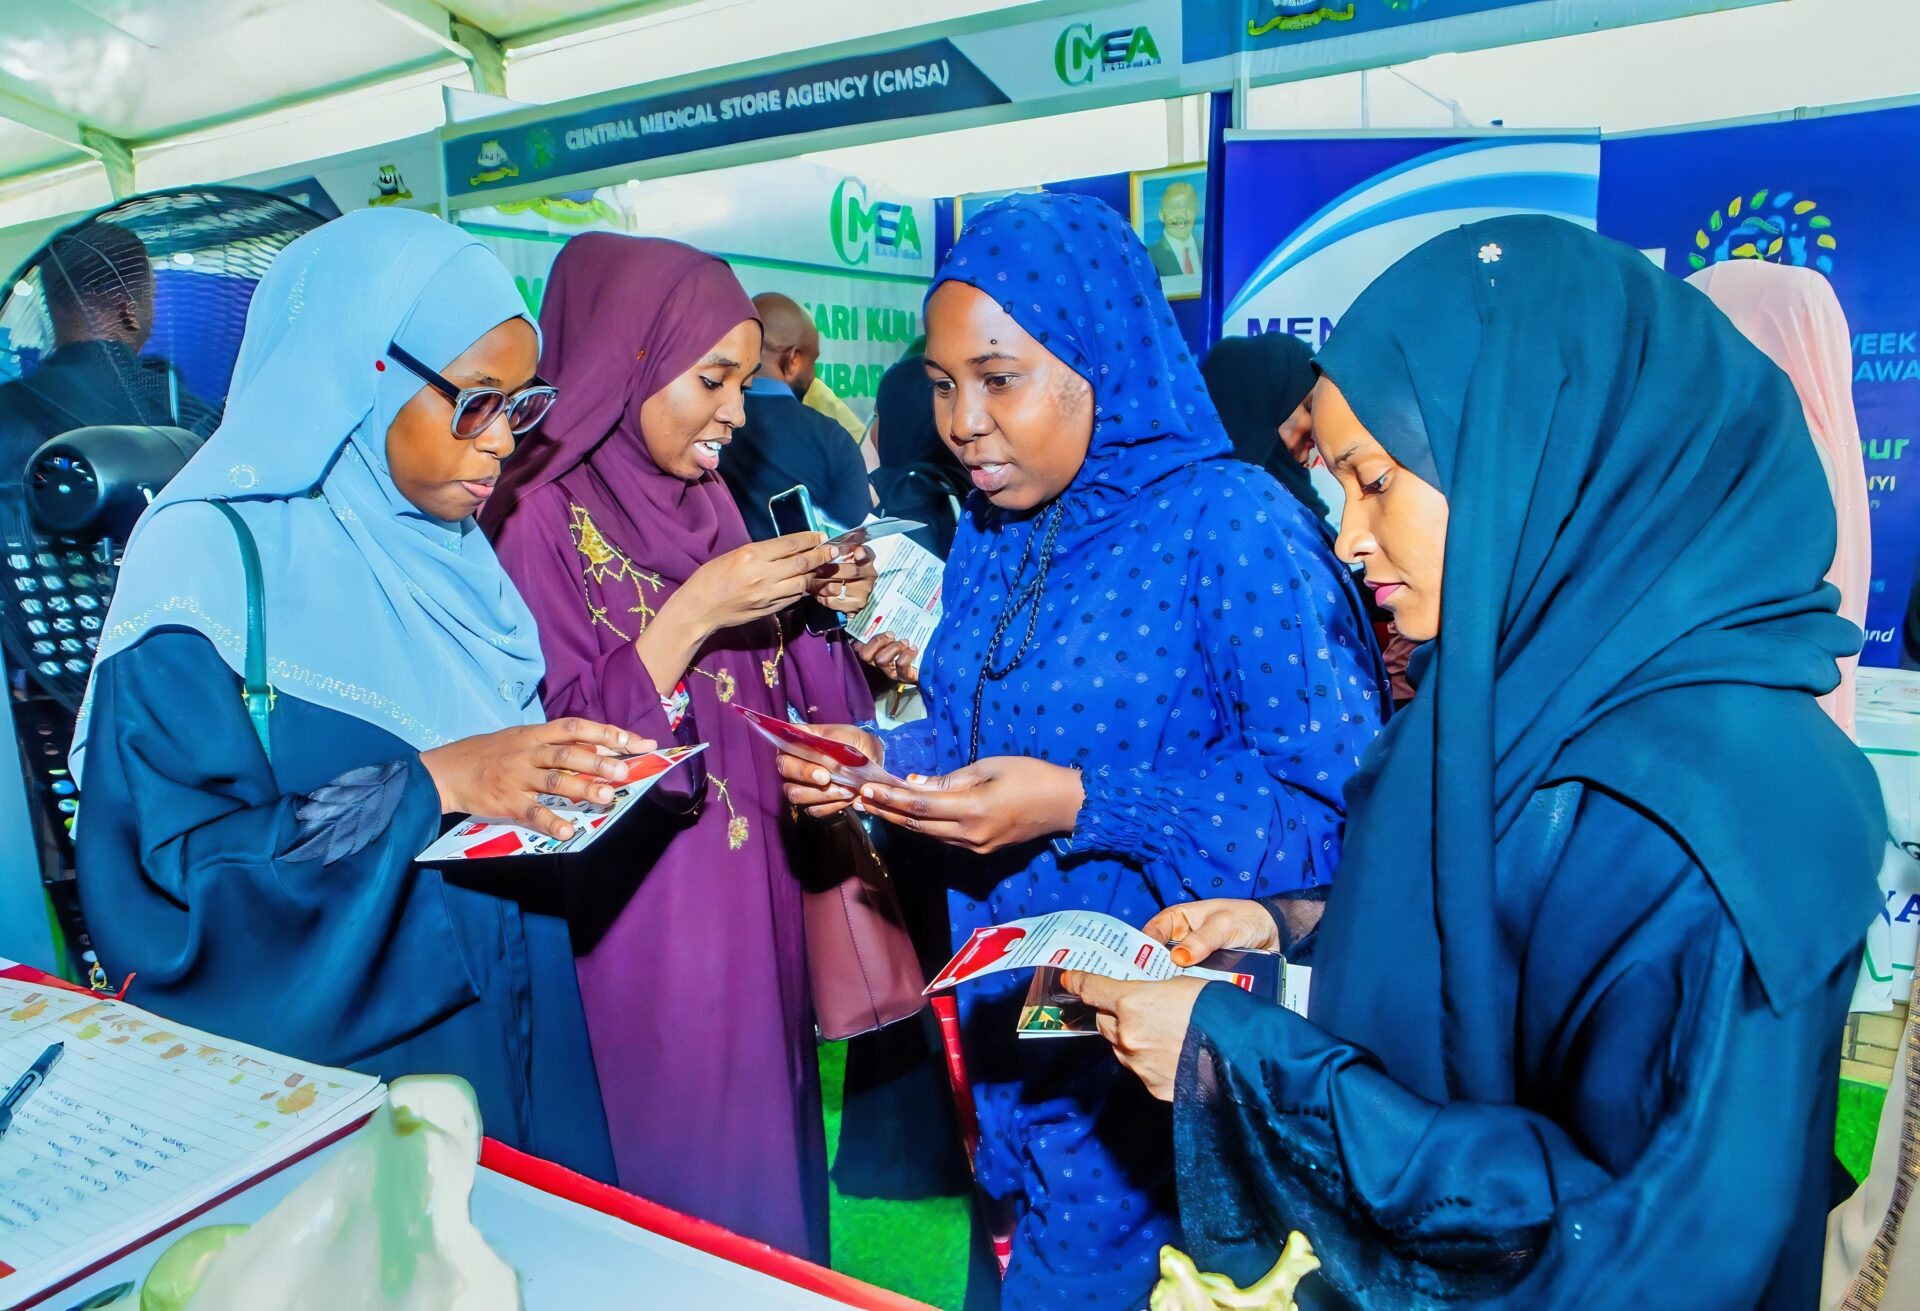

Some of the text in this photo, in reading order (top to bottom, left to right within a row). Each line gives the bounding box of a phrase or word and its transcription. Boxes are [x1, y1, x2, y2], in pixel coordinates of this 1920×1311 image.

[640, 102, 718, 135] MEDICAL
[719, 89, 782, 120] STORE
[785, 74, 869, 109] AGENCY
[873, 59, 950, 97] (CMSA)
[804, 302, 859, 341] ARI
[1861, 438, 1910, 460] ur
